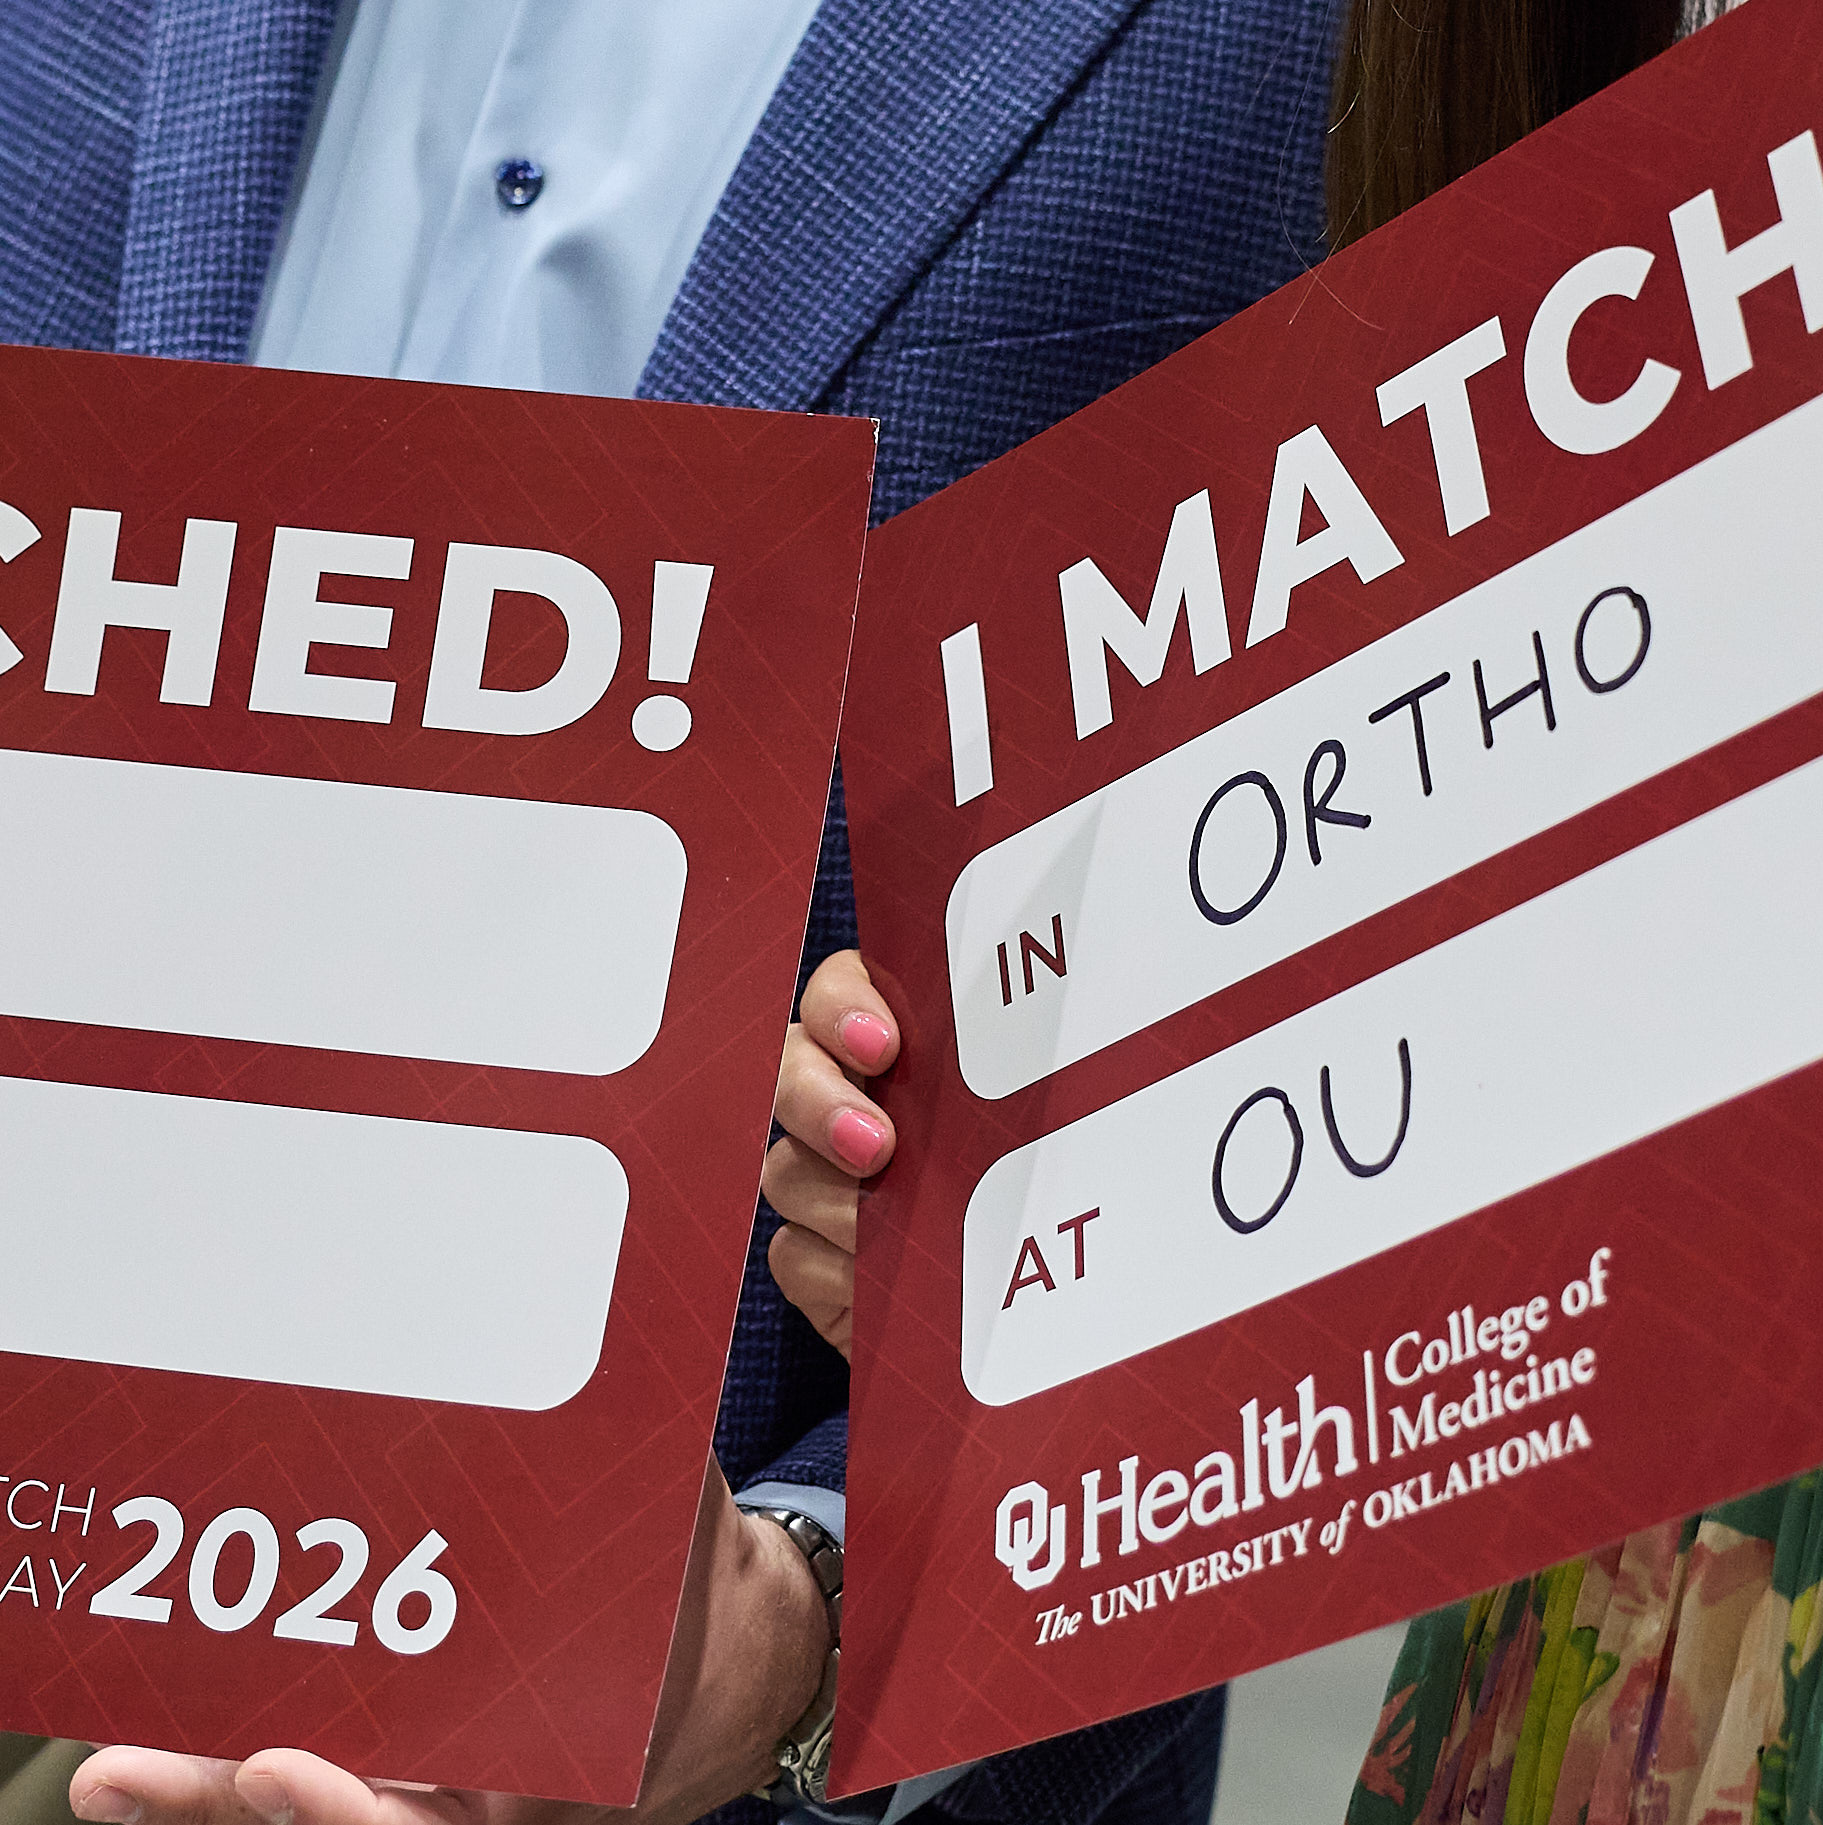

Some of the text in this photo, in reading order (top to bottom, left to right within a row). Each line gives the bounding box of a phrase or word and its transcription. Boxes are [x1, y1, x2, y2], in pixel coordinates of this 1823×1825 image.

[940, 622, 994, 807] I
[1188, 586, 1652, 926] ORTHO
[996, 913, 1068, 1007] IN
[1211, 1037, 1412, 1235] OU
[1001, 1206, 1101, 1311] AT
[1384, 1246, 1612, 1387] College of
[1080, 1374, 1361, 1569] Health
[1387, 1347, 1596, 1459] Medicine
[88, 1496, 458, 1655] 2026
[1034, 1413, 1592, 1646] The UNIVERSITY of OKLAHOMA
